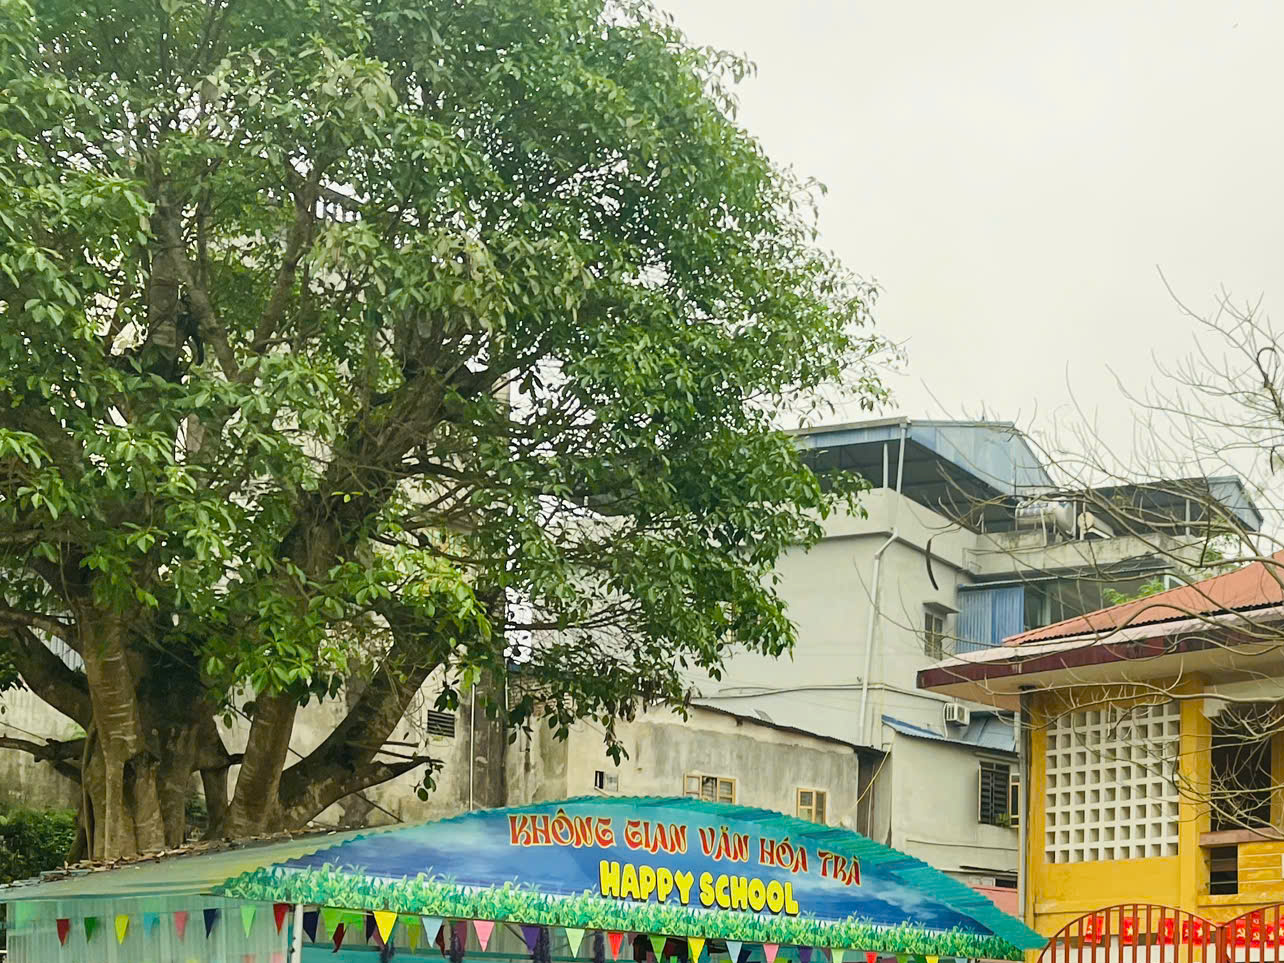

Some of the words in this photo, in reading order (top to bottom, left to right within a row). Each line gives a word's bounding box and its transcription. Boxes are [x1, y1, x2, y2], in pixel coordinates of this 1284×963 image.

[508, 808, 616, 847] KHÔNG
[624, 820, 688, 854] GIAN
[699, 827, 750, 862] VĂN
[759, 837, 808, 873] HÓA
[817, 850, 862, 886] TRÀ
[600, 860, 694, 904] HAPPY
[699, 872, 799, 915] SCHOOL
